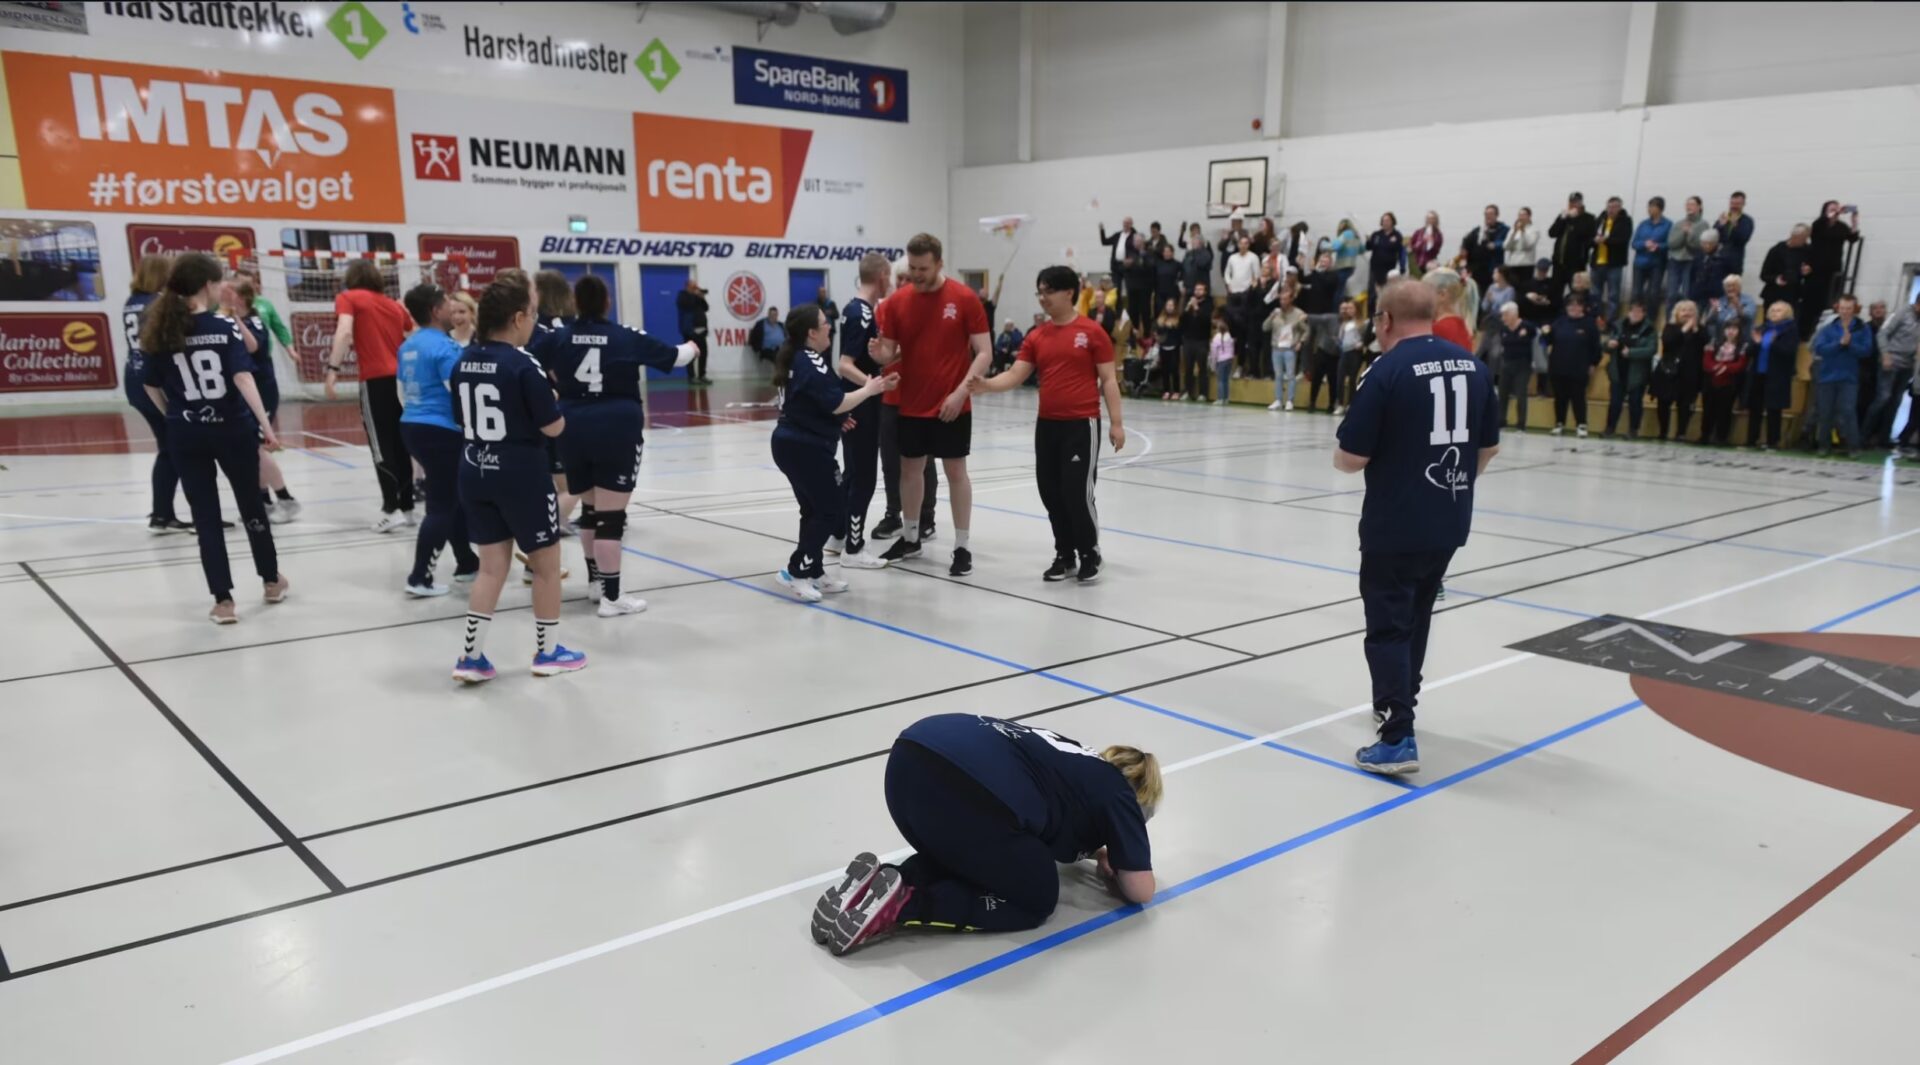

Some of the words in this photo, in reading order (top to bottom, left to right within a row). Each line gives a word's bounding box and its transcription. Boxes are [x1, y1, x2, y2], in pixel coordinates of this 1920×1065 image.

[464, 25, 628, 74] Harstadmester
[754, 58, 861, 94] SpareBank
[784, 89, 861, 110] NORD-NORGE
[69, 72, 348, 168] IMTAS
[469, 137, 626, 176] NEUMANN
[88, 171, 354, 209] #førstevalget
[471, 173, 518, 186] Sammen
[648, 156, 772, 203] renta
[540, 236, 643, 257] BILTREND
[643, 239, 734, 258] HARSTAD
[745, 242, 830, 260] BILTREND
[0, 327, 61, 351] larion
[3, 351, 102, 370] Collection
[172, 349, 227, 401] 18
[460, 361, 498, 374] KARLSEN
[574, 347, 603, 392] 4
[1412, 361, 1442, 376] BERG
[1444, 359, 1476, 373] OLSEN
[458, 382, 507, 441] 16
[1429, 374, 1469, 446] 11
